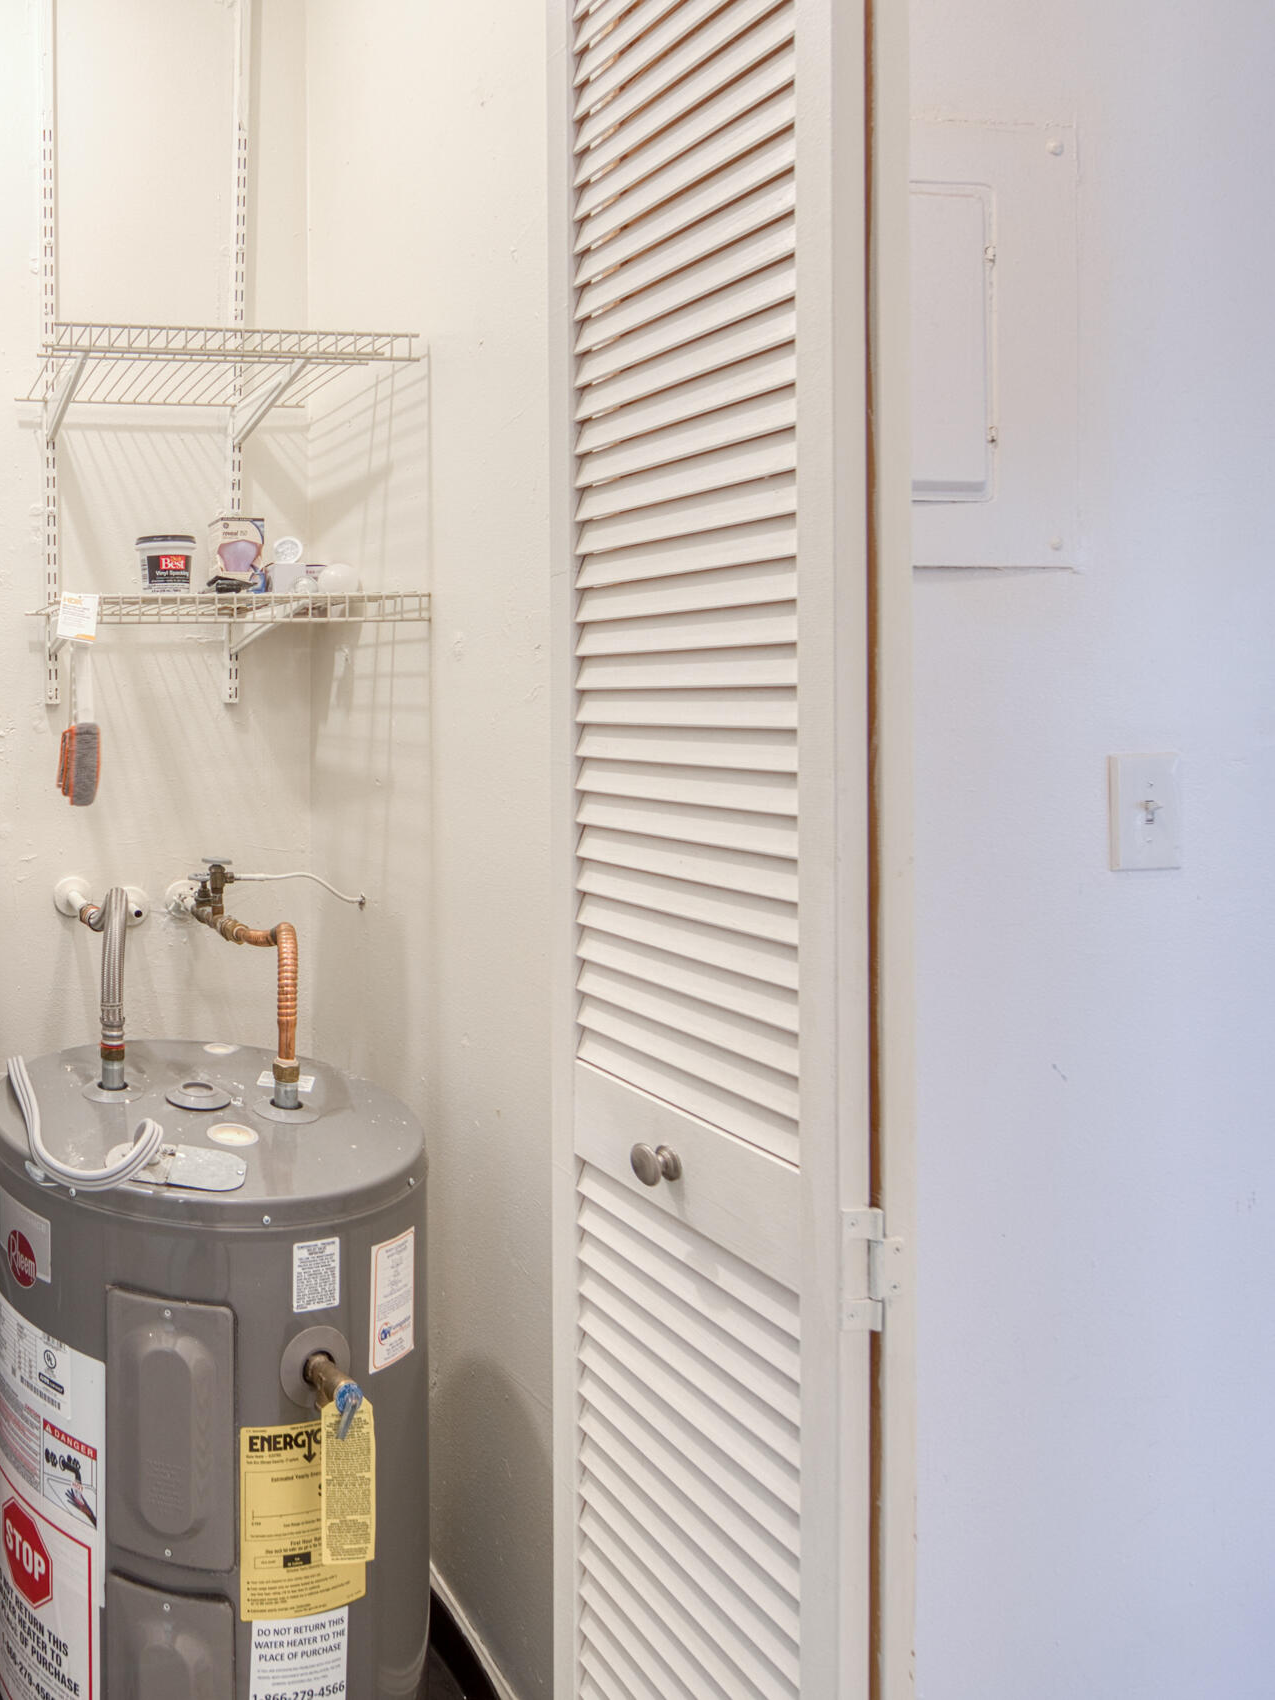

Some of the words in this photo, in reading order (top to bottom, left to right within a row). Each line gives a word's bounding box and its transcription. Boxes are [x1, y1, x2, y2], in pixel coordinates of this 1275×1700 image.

[160, 556, 185, 570] Best
[9, 1231, 36, 1281] Rheem
[54, 1429, 95, 1458] DANGER
[5, 1517, 46, 1582] STOP
[15, 1594, 45, 1636] RETURN
[47, 1628, 69, 1657] THIS
[17, 1612, 48, 1656] HEATER
[50, 1647, 62, 1668] TO
[254, 1640, 285, 1650] WATER
[286, 1635, 318, 1648] HEATER
[320, 1633, 330, 1642] TO
[332, 1628, 346, 1640] THE
[257, 1627, 271, 1637] DO
[273, 1627, 292, 1637] NOT
[293, 1621, 326, 1635] RETURN
[328, 1616, 345, 1628] THIS
[2, 1631, 57, 1700] 1-866-279-456
[19, 1631, 29, 1649] OF
[31, 1645, 80, 1698] PURCHASE
[258, 1651, 285, 1662] PLACE
[287, 1650, 299, 1661] OF
[300, 1642, 342, 1659] PURCHASE
